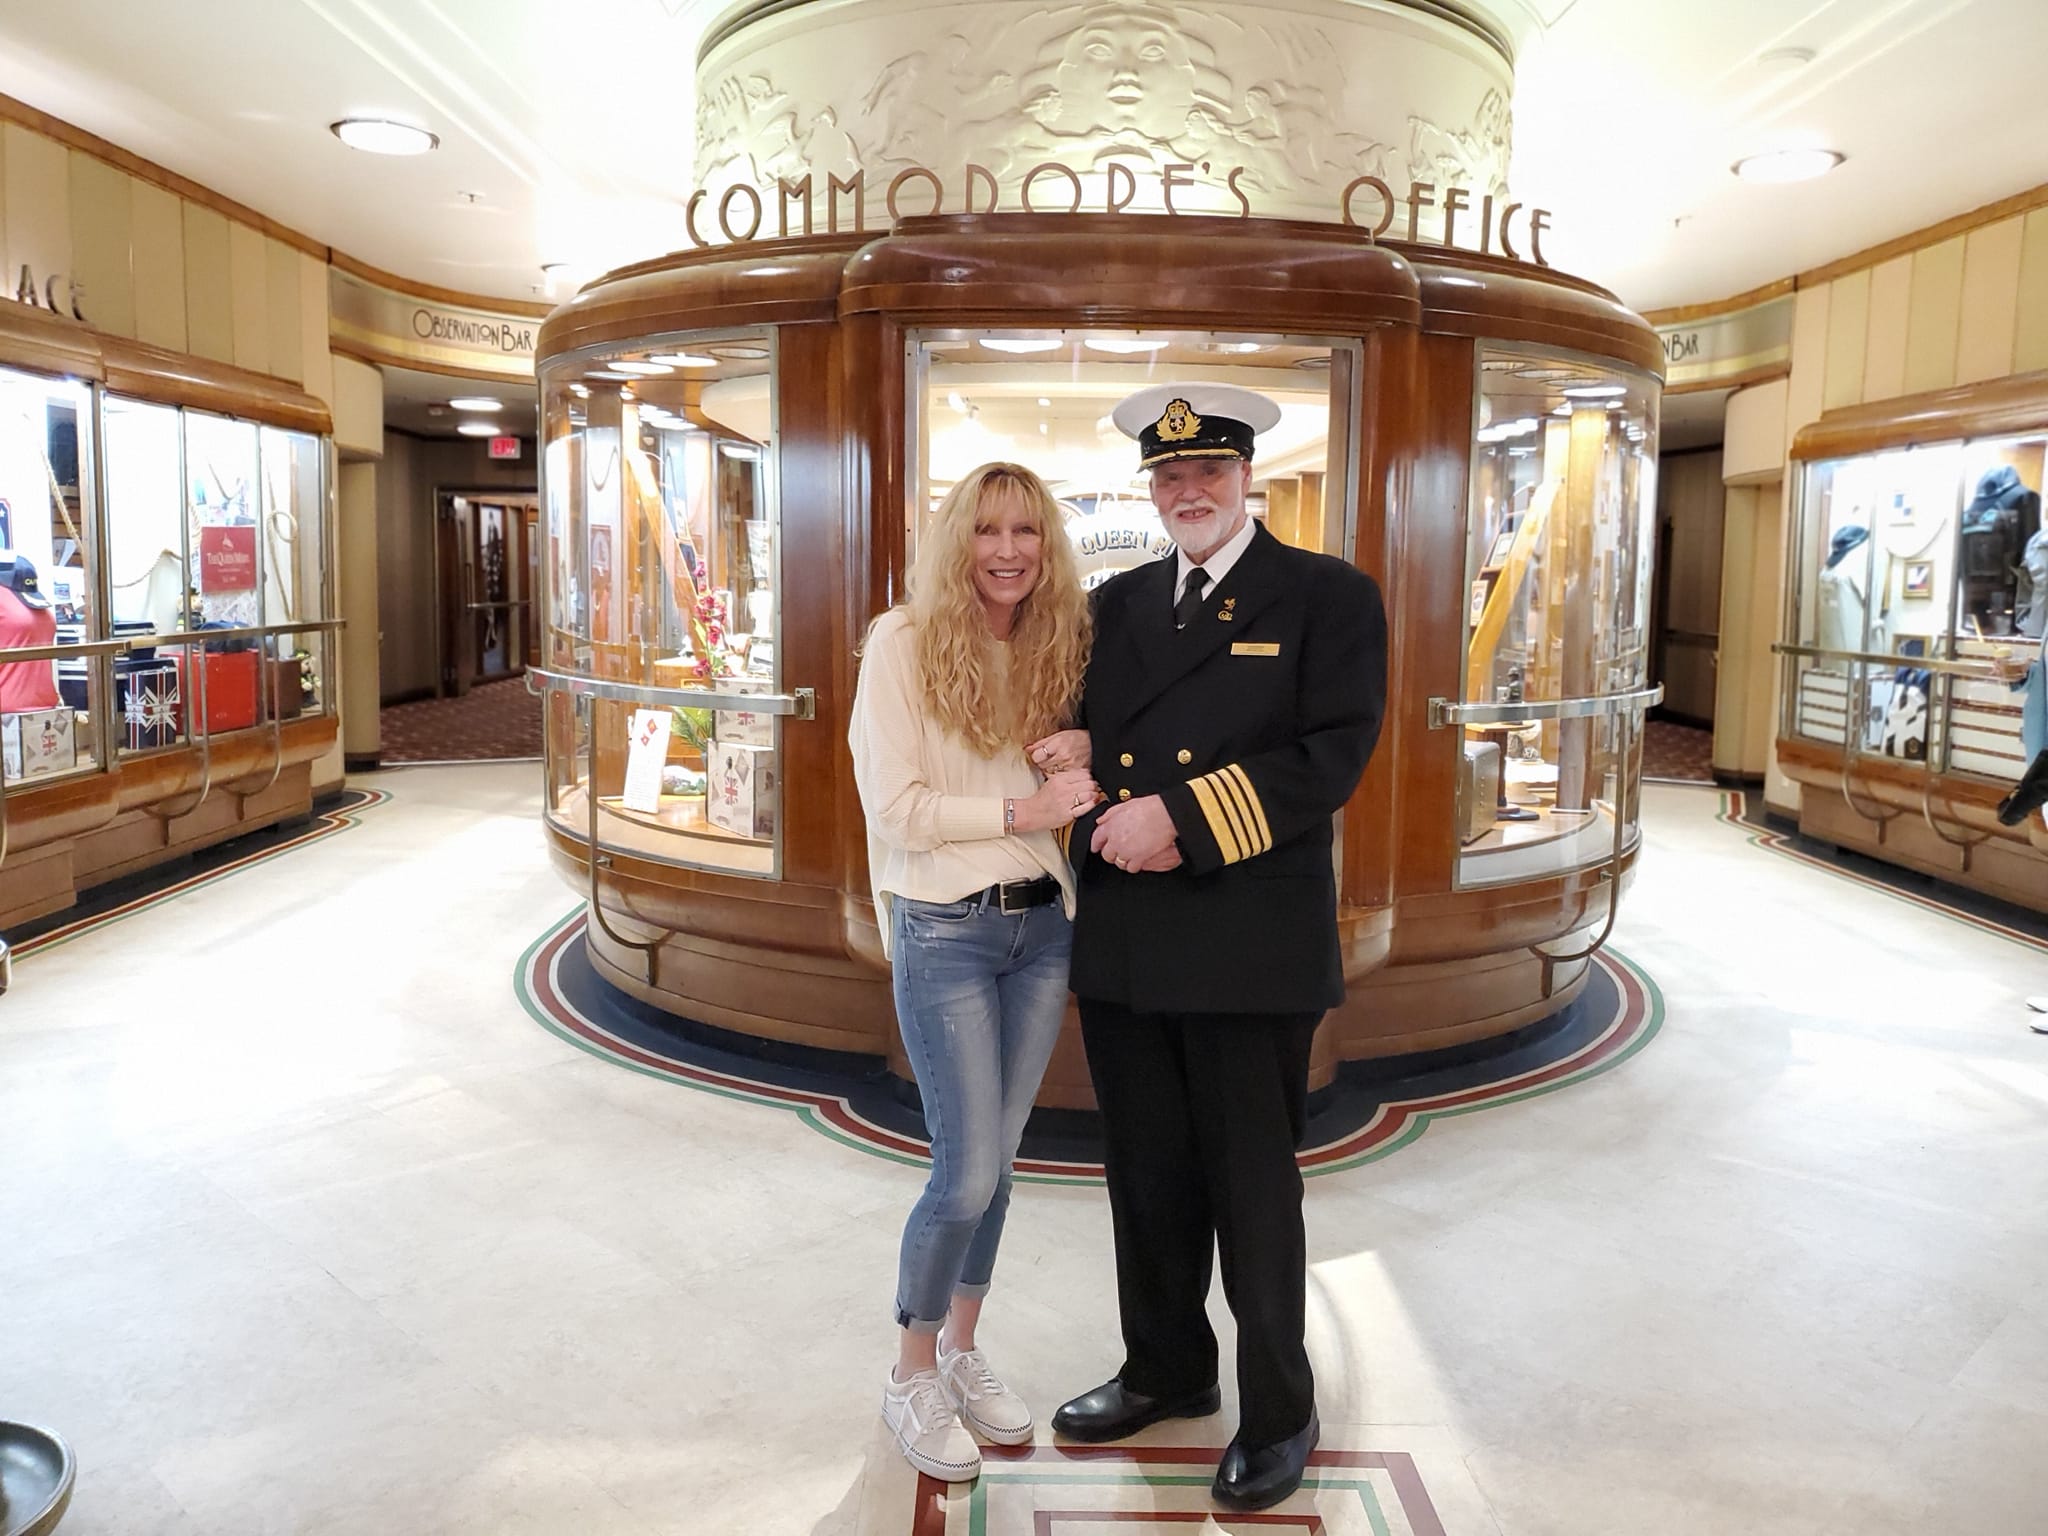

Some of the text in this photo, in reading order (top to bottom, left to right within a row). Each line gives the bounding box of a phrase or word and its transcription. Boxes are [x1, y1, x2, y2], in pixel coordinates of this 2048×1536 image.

[686, 161, 1552, 268] COMMODORE'S OFFICE
[412, 309, 533, 352] OBSERVATION BAR
[1671, 333, 1700, 361] BAR
[1081, 530, 1149, 555] QUEEN
